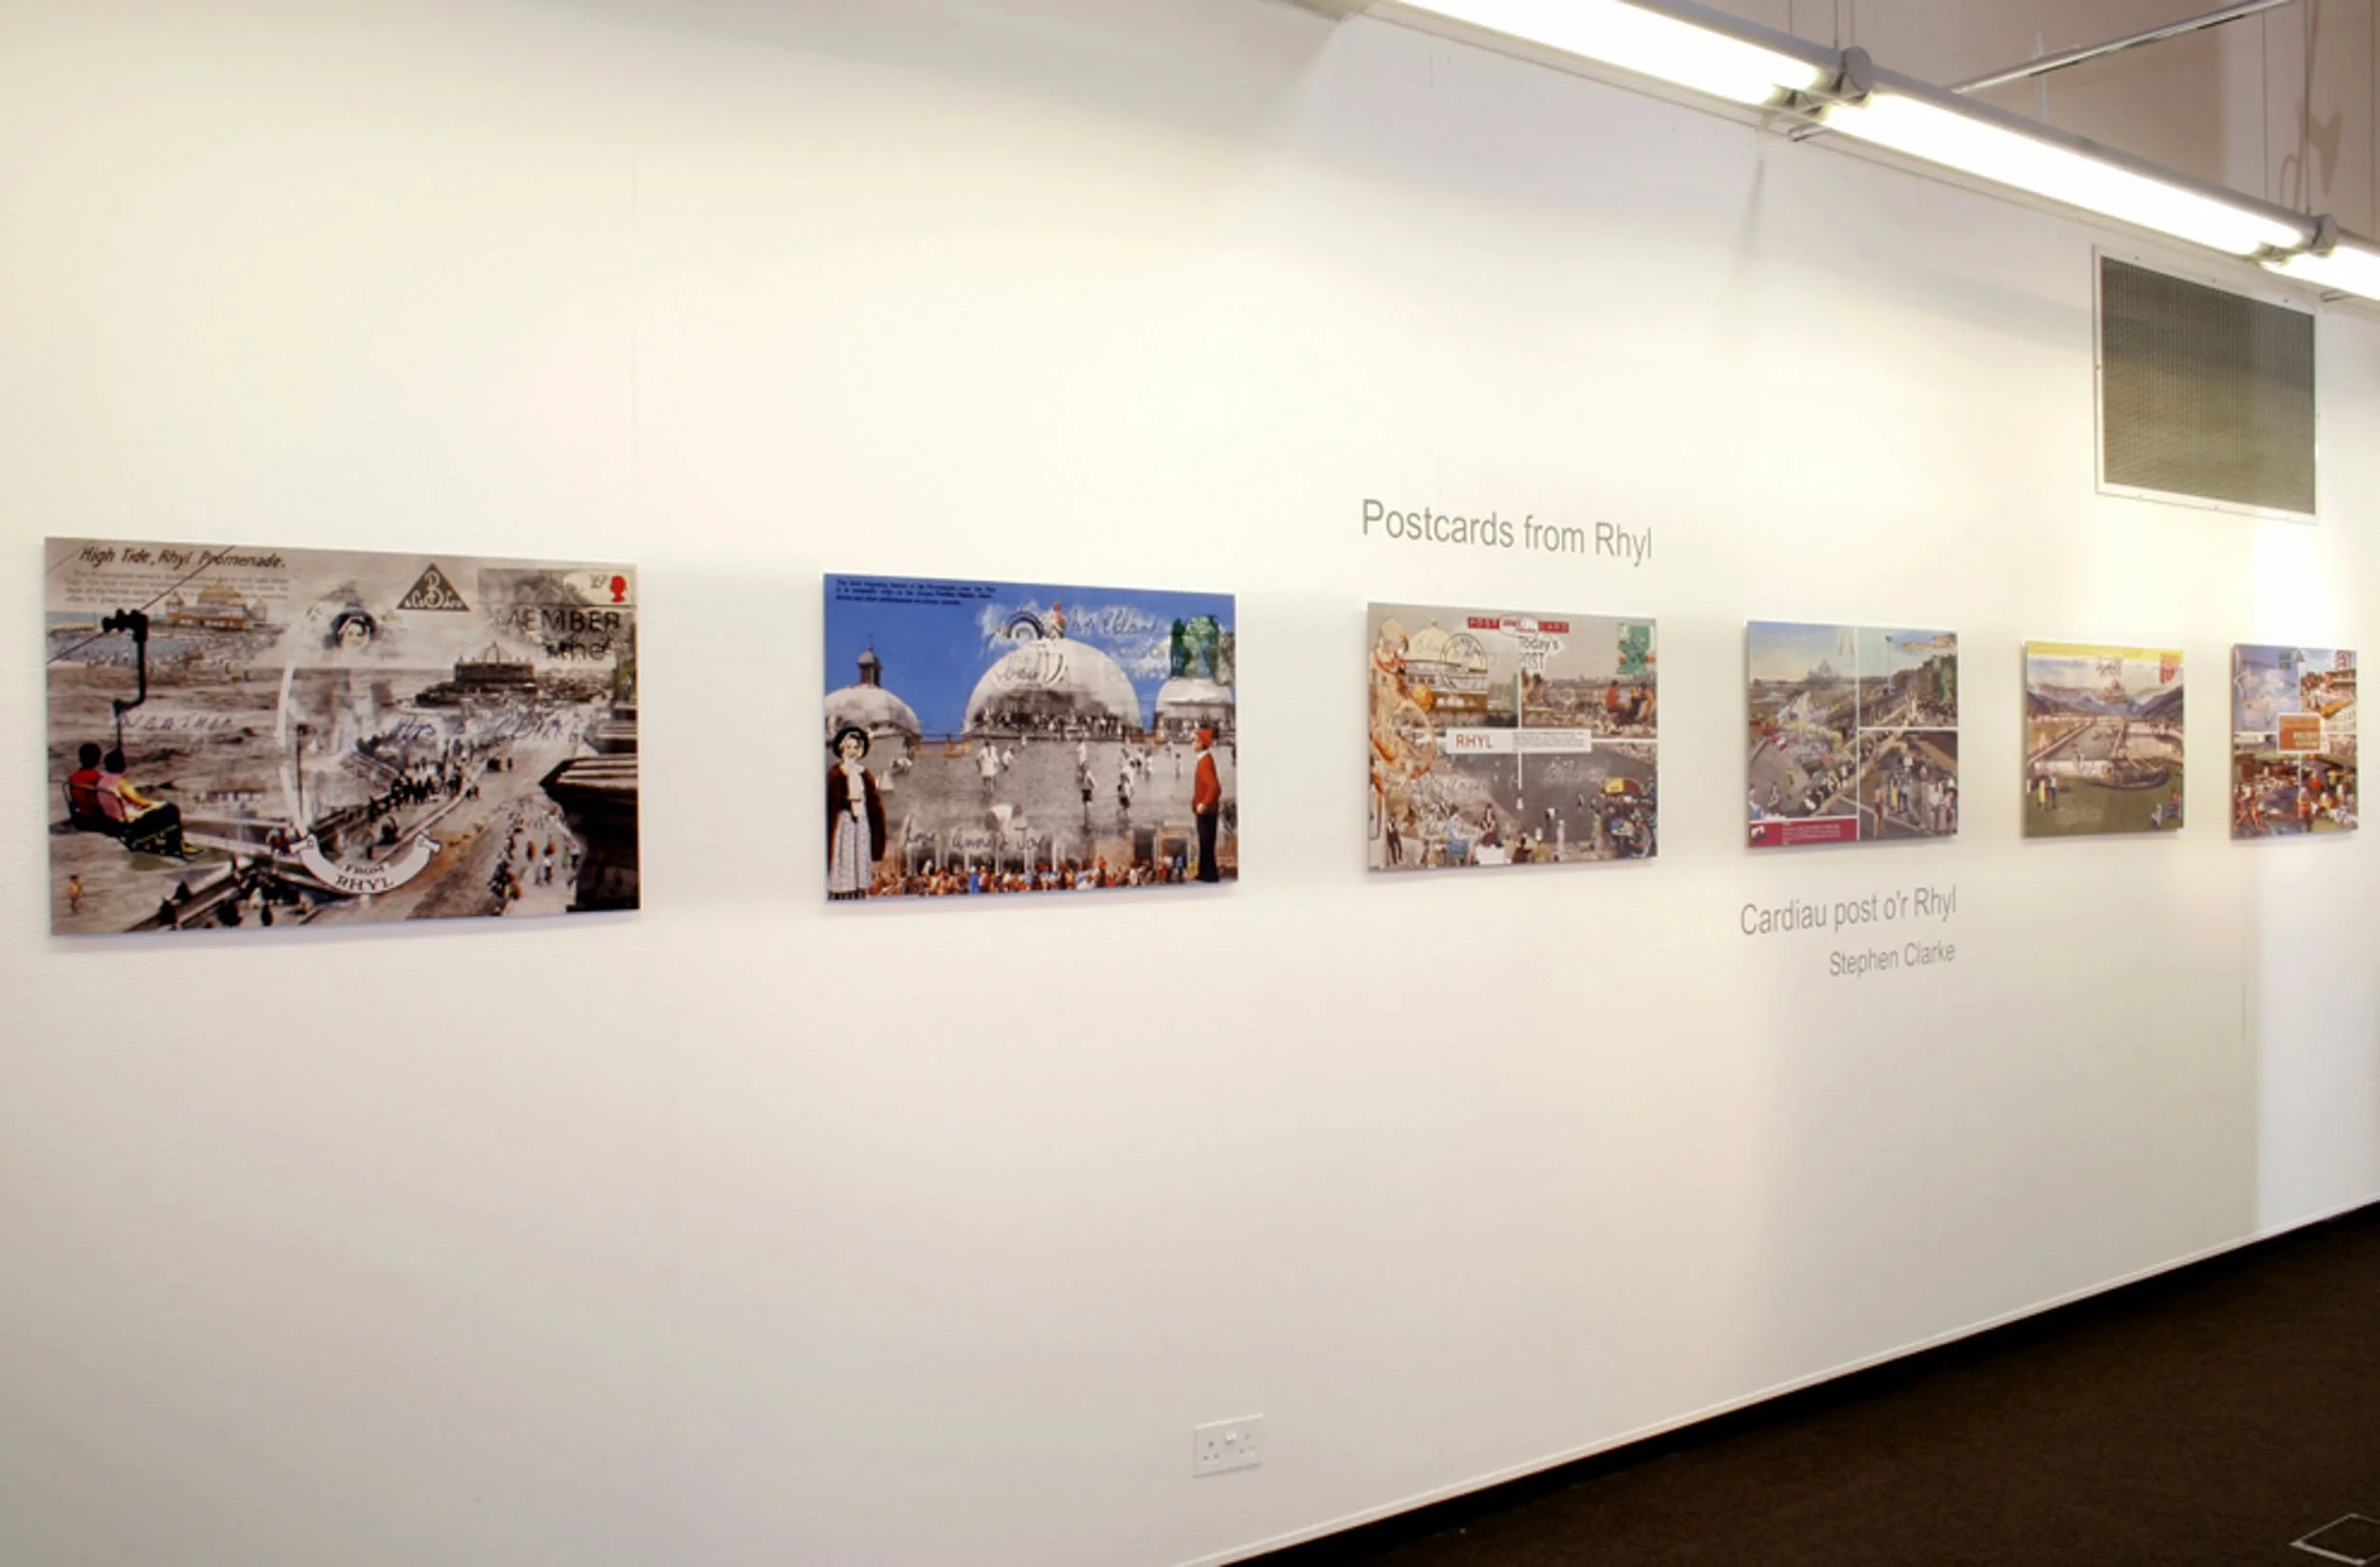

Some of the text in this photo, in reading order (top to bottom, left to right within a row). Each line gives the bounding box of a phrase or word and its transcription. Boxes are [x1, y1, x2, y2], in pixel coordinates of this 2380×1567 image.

[1362, 498, 1652, 567] Postcards from Rhyl
[79, 546, 115, 569] High
[158, 549, 194, 570] Rhyl
[1456, 733, 1494, 749] RHYL
[335, 873, 394, 891] RHYL
[1740, 884, 1956, 936] Cardiau post o'r Rhyl
[1829, 939, 1956, 979] Stephen Clarke
